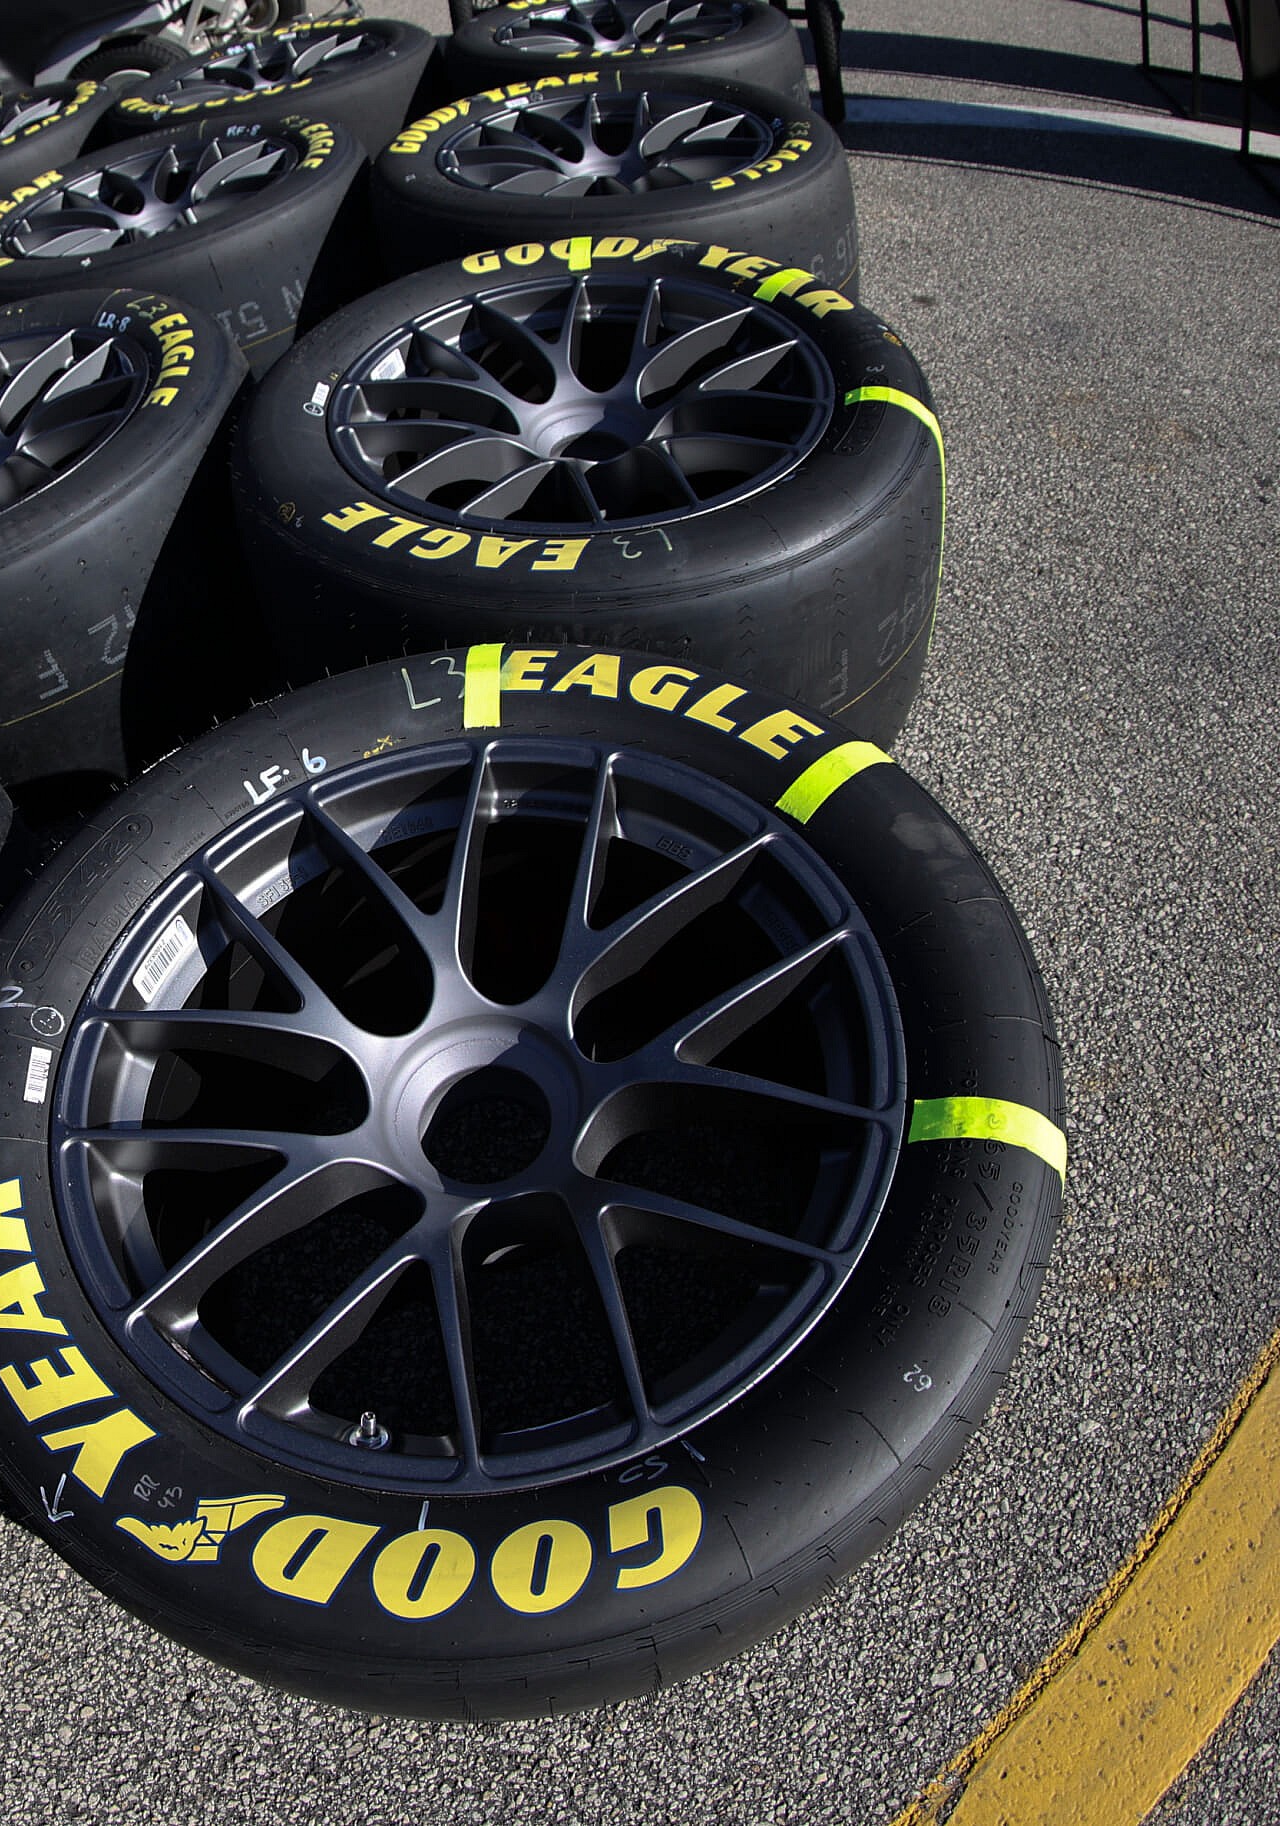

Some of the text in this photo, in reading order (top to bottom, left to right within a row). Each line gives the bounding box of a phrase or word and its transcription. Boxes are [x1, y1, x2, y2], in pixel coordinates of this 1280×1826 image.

[299, 122, 336, 169] EAGLE
[709, 138, 813, 191] EAGLE
[149, 312, 195, 408] EAGLE
[322, 501, 593, 571] EAGLE
[501, 648, 826, 760] EAGLE
[79, 877, 156, 963] RADIAL
[987, 1180, 1024, 1275] GOODYEAR
[251, 1484, 705, 1619] GOOD
